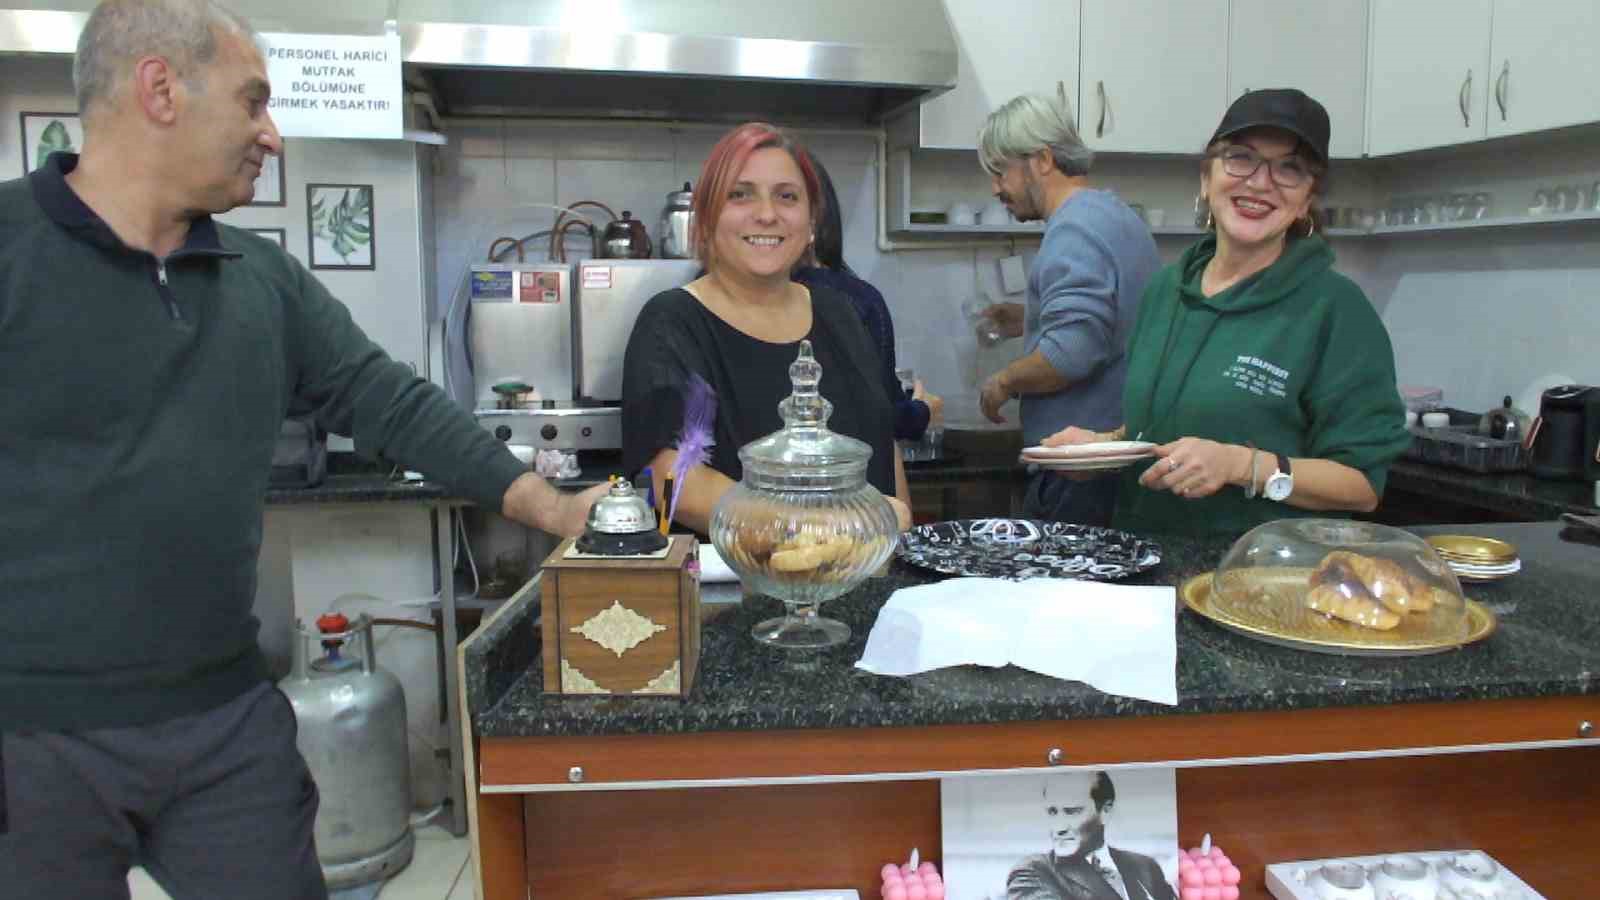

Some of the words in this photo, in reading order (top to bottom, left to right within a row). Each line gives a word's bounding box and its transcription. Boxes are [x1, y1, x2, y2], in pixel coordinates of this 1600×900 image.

[268, 48, 339, 61] PERSONEL
[302, 66, 356, 77] MUTFAK
[291, 81, 366, 94] BÖLÜMÜNE
[267, 96, 318, 109] GİRMEK
[322, 98, 390, 111] YASAKTIR!
